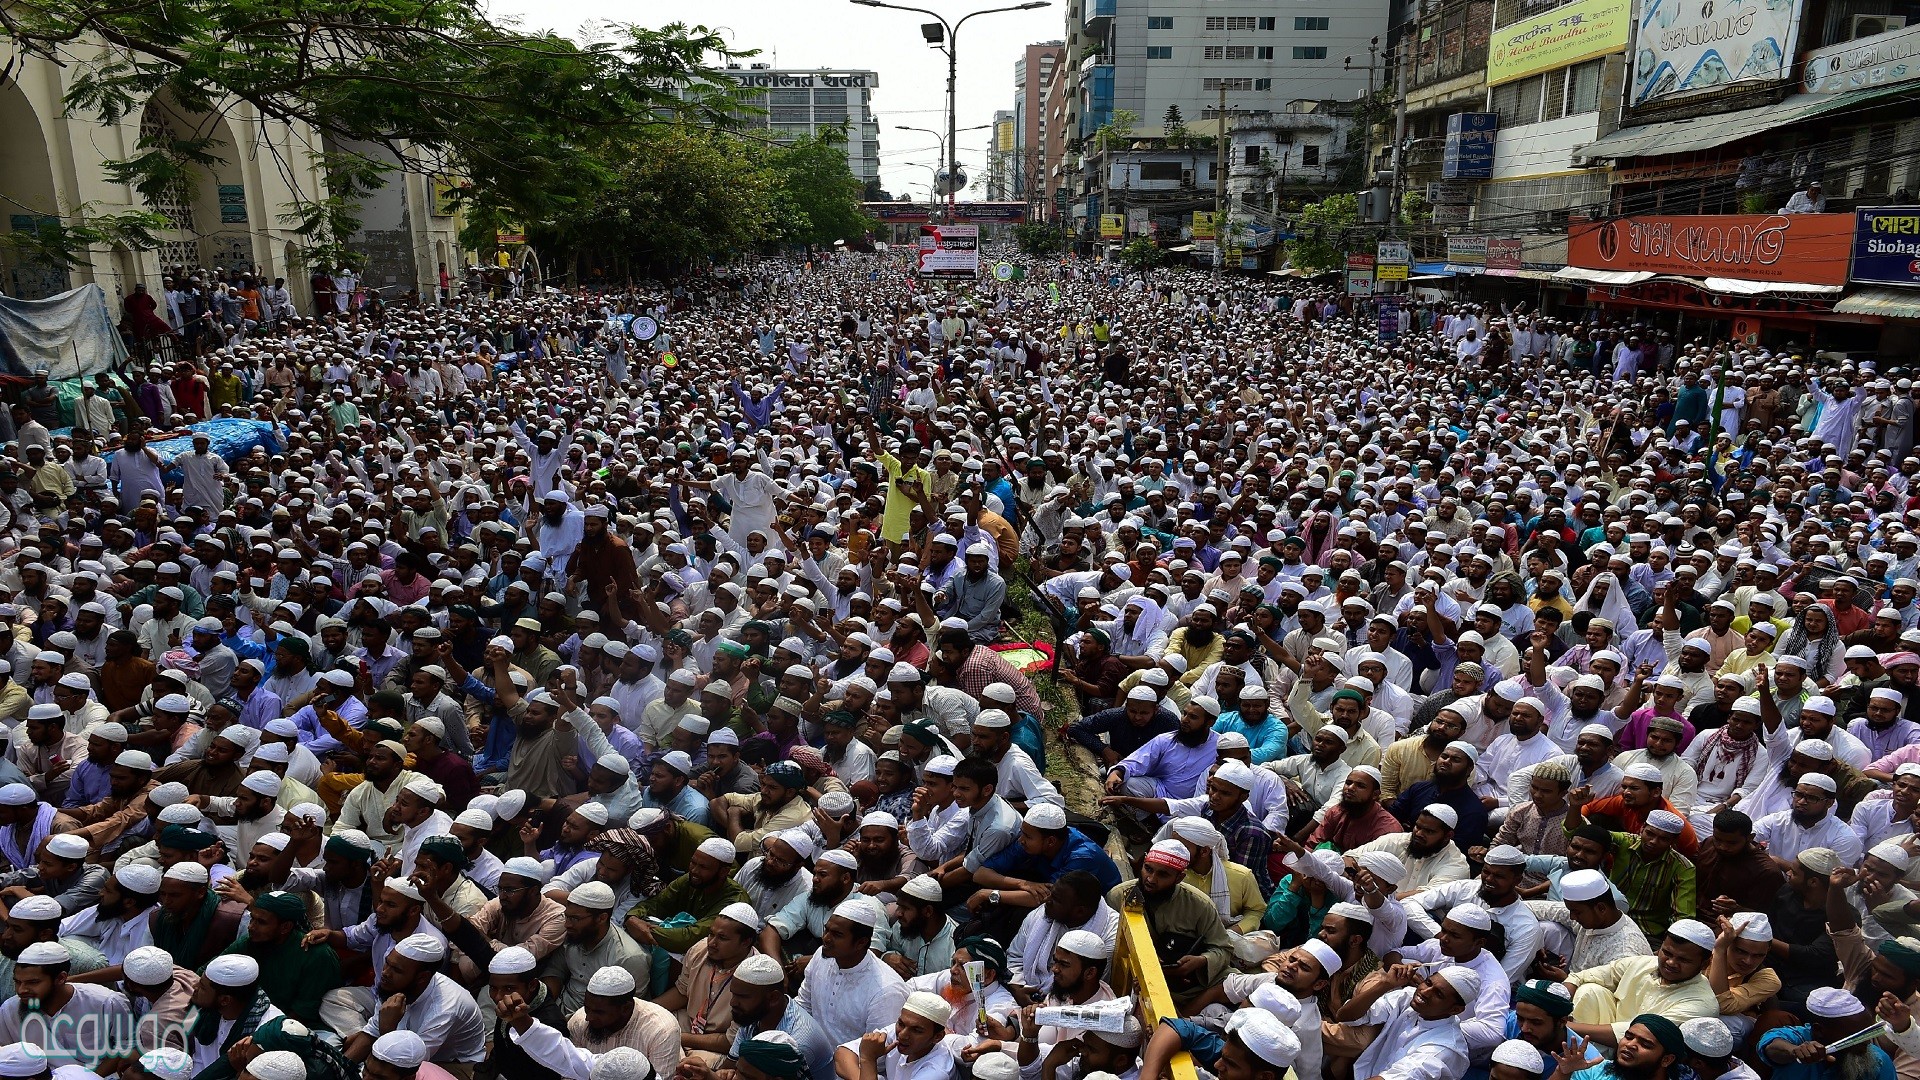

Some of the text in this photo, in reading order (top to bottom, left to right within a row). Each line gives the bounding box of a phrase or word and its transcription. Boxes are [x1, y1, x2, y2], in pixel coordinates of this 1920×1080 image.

[1508, 23, 1553, 47] হোটেল
[1558, 12, 1589, 27] বন্ধু
[1507, 41, 1537, 58] Hotel
[1539, 26, 1588, 47] Bandhu
[738, 75, 866, 88] সকালের খবর
[1351, 279, 1369, 288] বন্ধু
